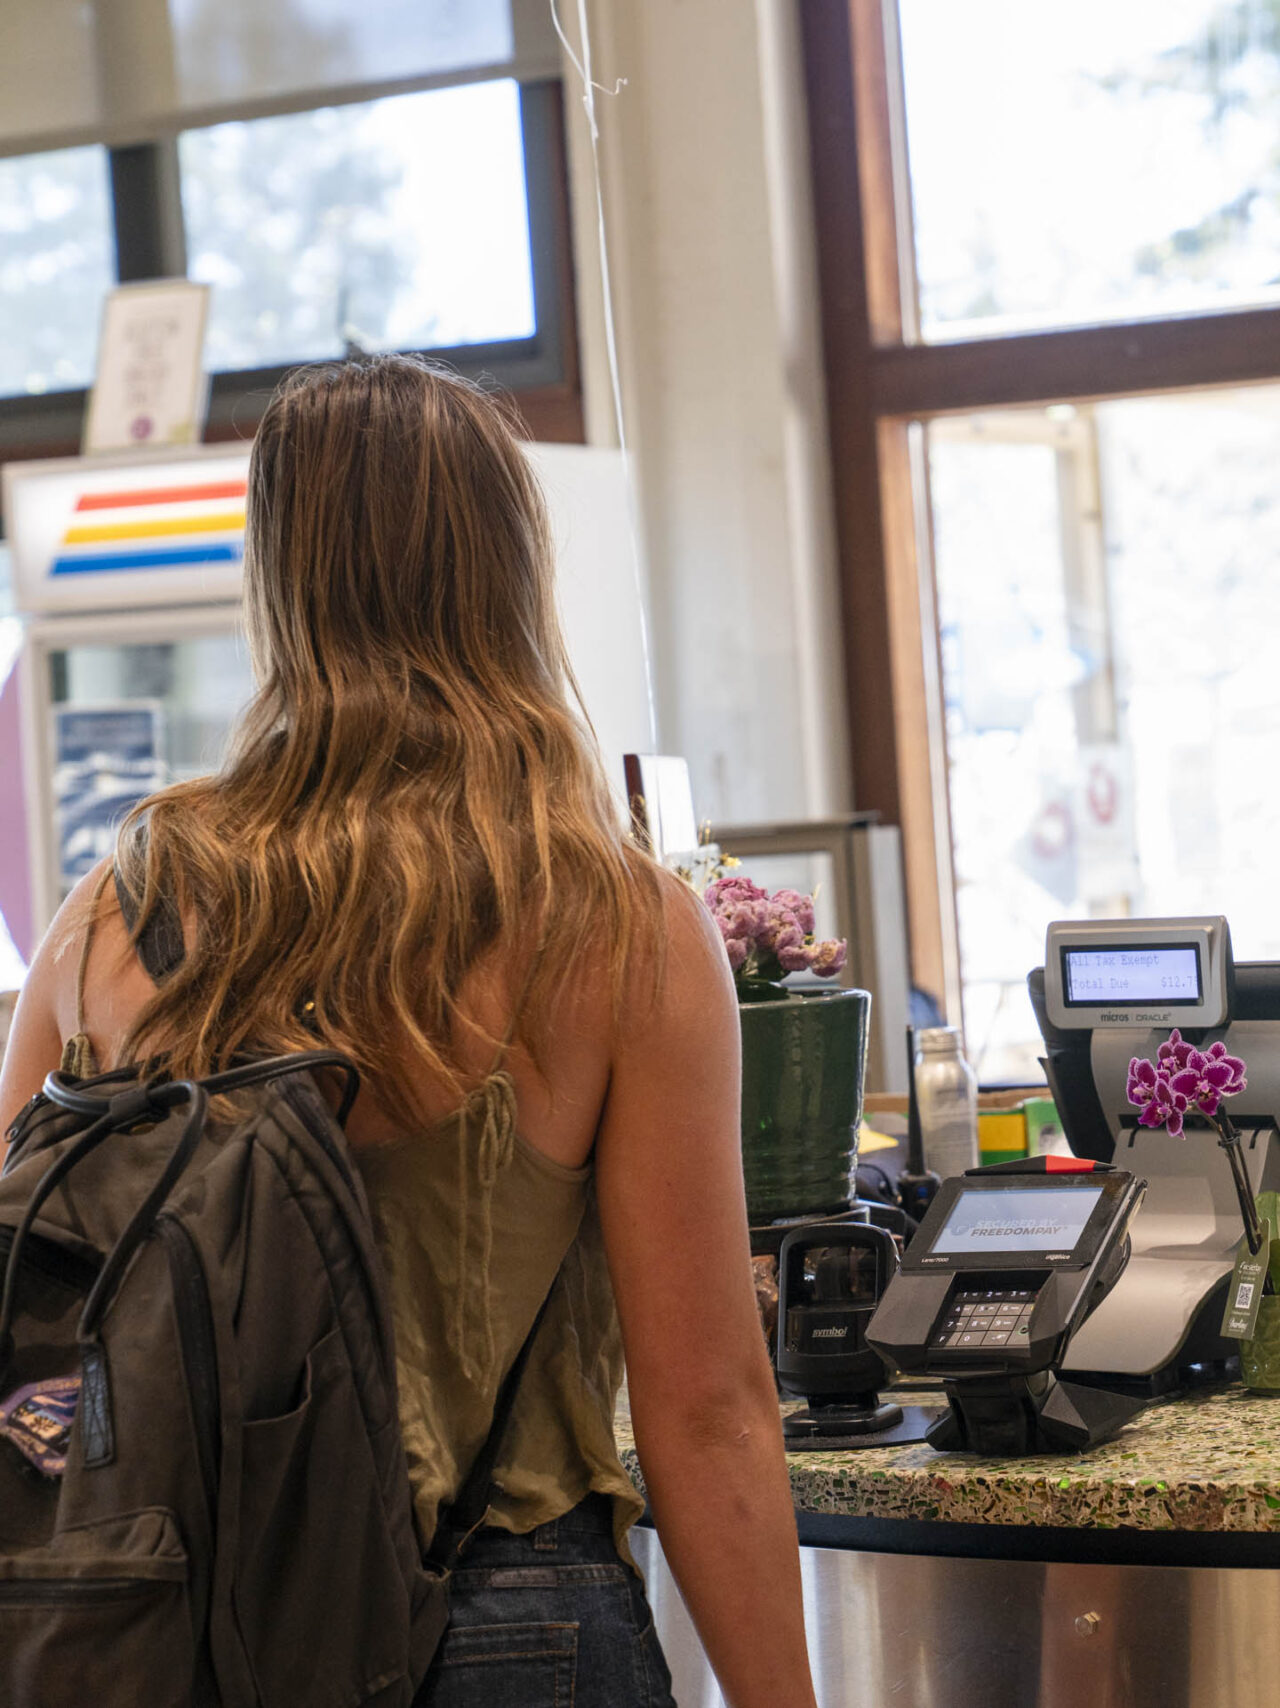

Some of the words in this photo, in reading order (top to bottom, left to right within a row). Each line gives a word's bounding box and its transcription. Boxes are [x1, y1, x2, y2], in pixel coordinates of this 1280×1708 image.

[1070, 954, 1089, 967] All
[1096, 954, 1116, 967] Tax
[1121, 953, 1160, 968] Exempt
[1072, 978, 1104, 990] Total
[1110, 977, 1129, 989] Due
[1160, 975, 1198, 989] $12.7
[1100, 1010, 1130, 1022] micros
[811, 1326, 848, 1338] symbol
